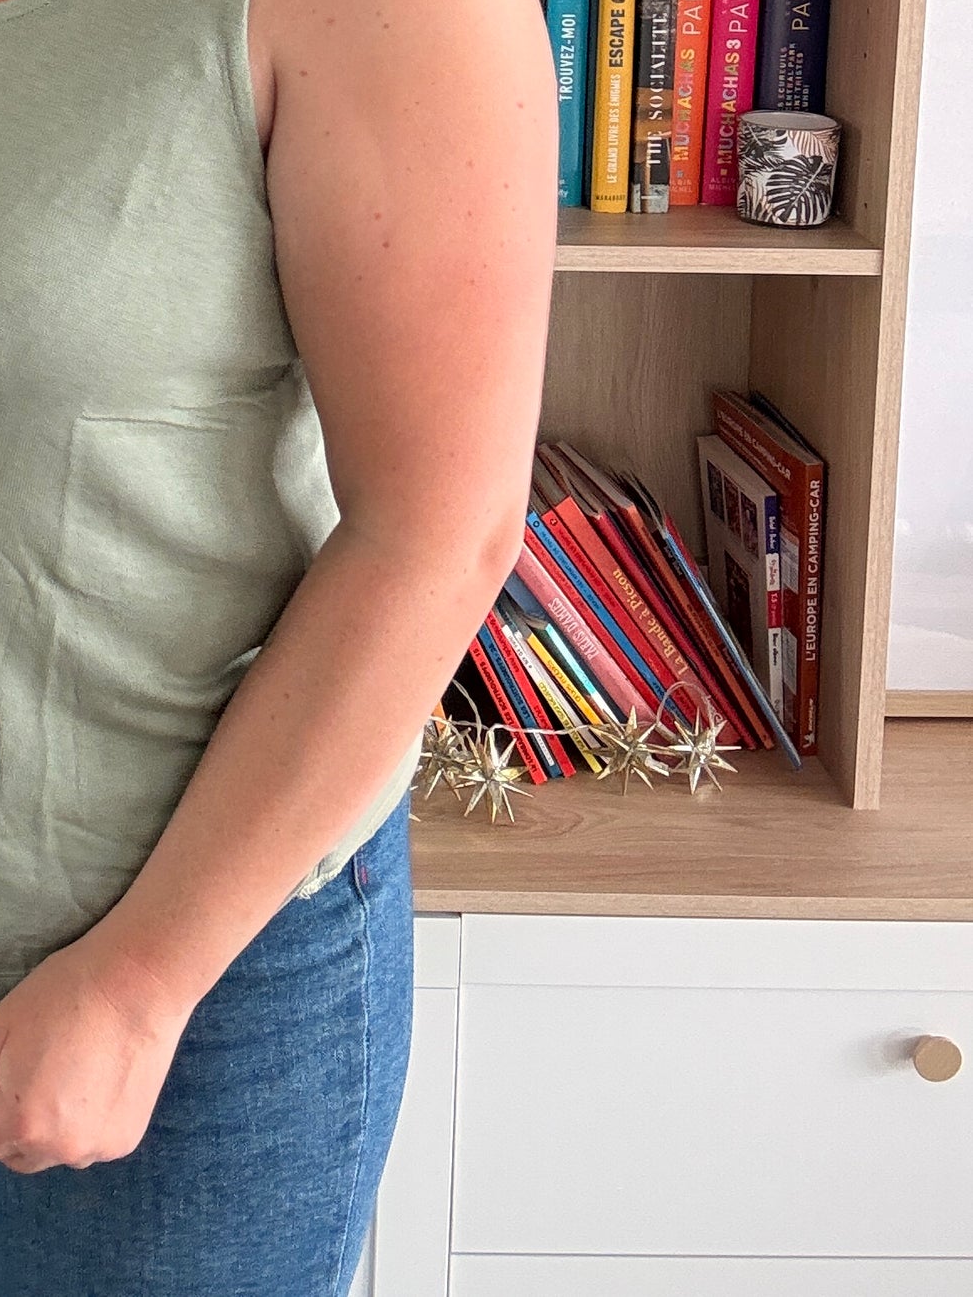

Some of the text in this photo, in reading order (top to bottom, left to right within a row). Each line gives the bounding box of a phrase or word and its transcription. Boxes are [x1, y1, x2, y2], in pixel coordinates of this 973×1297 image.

[559, 14, 576, 101] TROUVEZ-MOI
[609, 10, 625, 68] ESCAPE
[648, 13, 666, 120] SOCIALITE
[674, 49, 694, 161] MUCHACHAS
[718, 39, 742, 164] MUCHACHAS 3
[646, 131, 662, 167] THE
[611, 568, 644, 611] Picsou
[805, 480, 820, 661] L'EUROPE EN CAMPING-CAR
[649, 622, 677, 658] Bande
[668, 653, 689, 675] La
